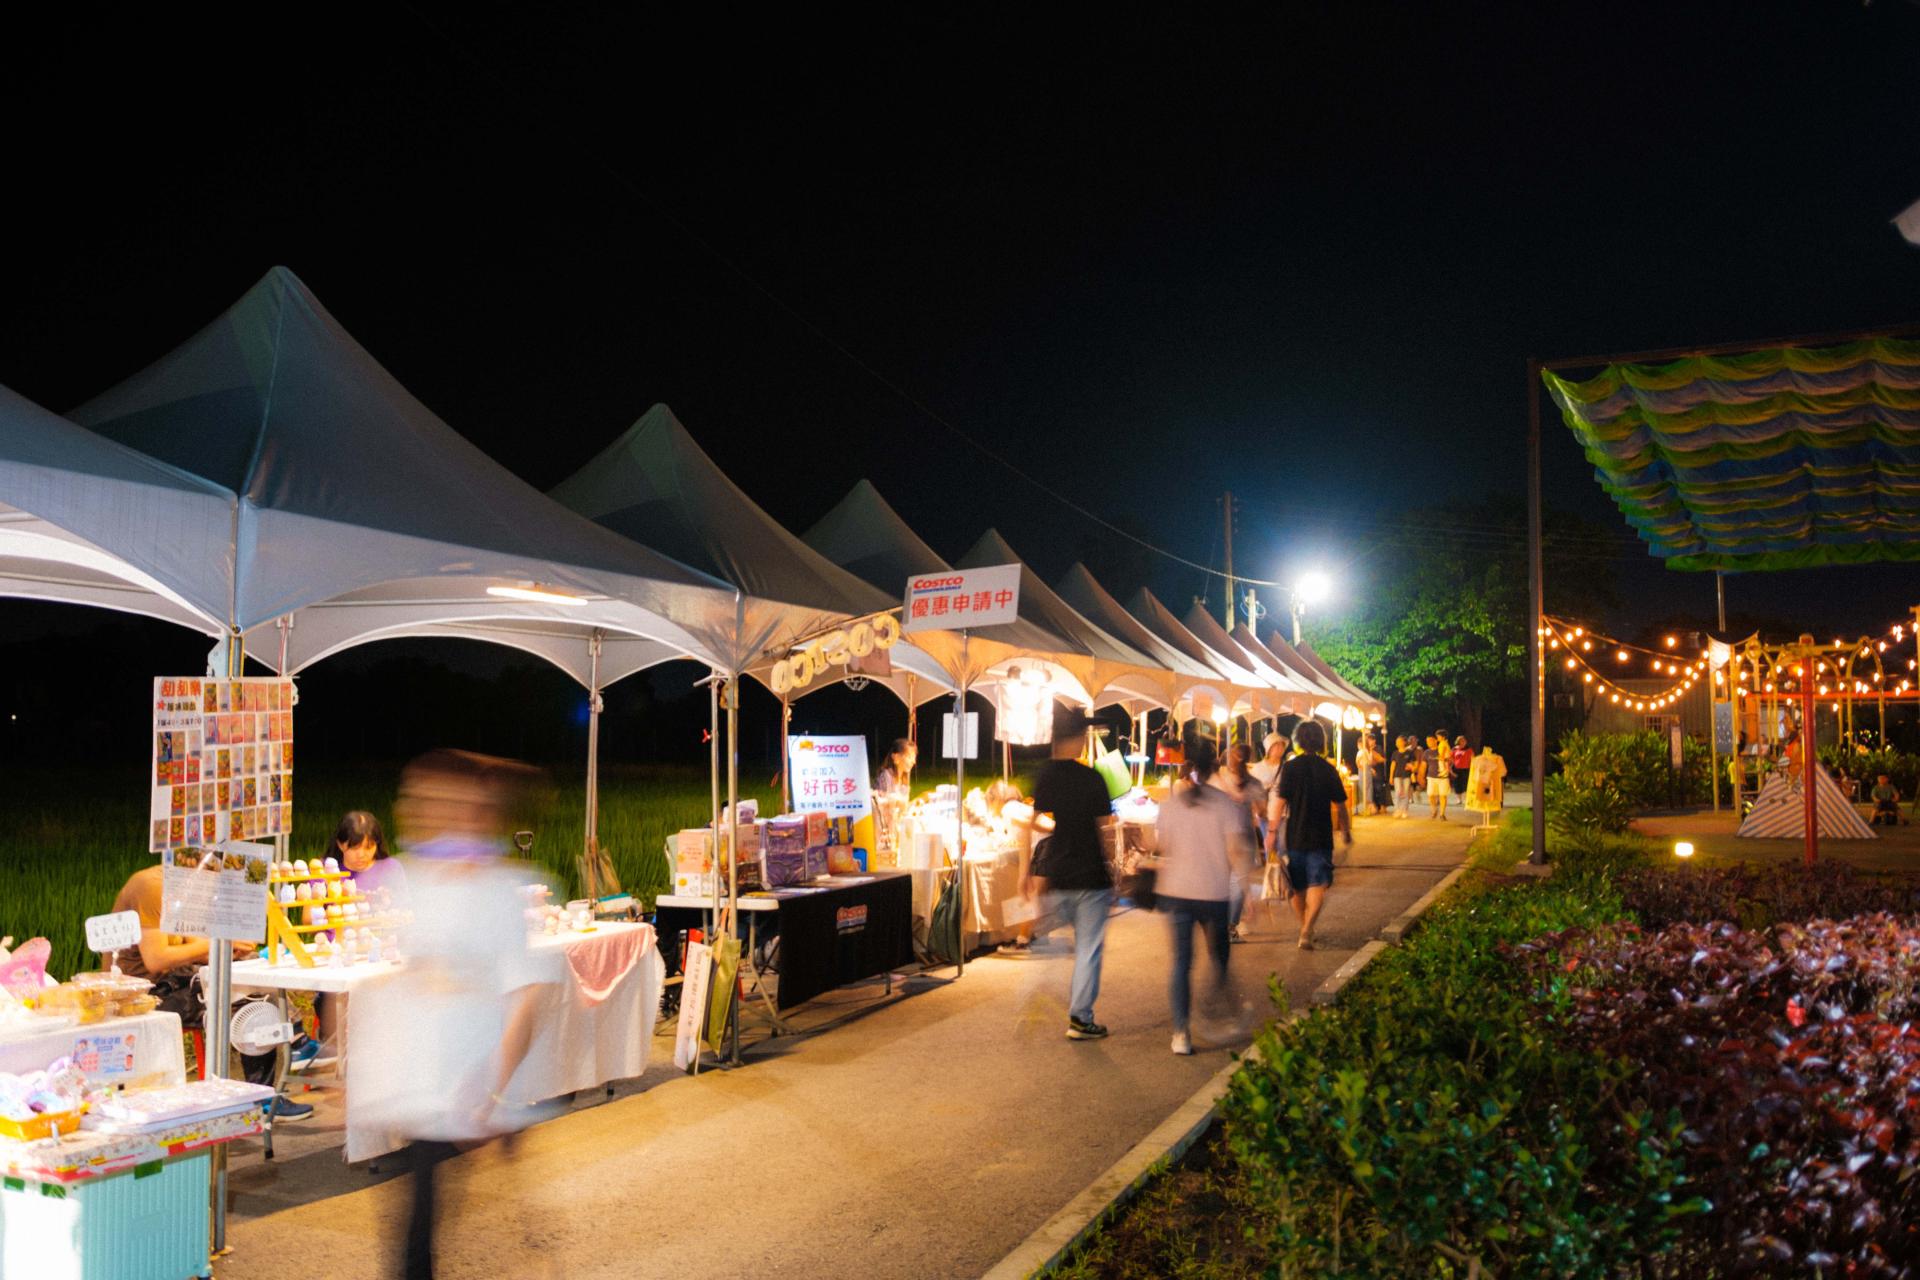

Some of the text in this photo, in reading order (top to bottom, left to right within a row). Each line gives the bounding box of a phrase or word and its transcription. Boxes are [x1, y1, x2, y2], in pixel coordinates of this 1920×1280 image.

[913, 576, 964, 590] COSTCO
[911, 589, 1014, 619] 優惠申請中
[812, 744, 850, 753] OSTCO
[803, 778, 857, 796] 好市多
